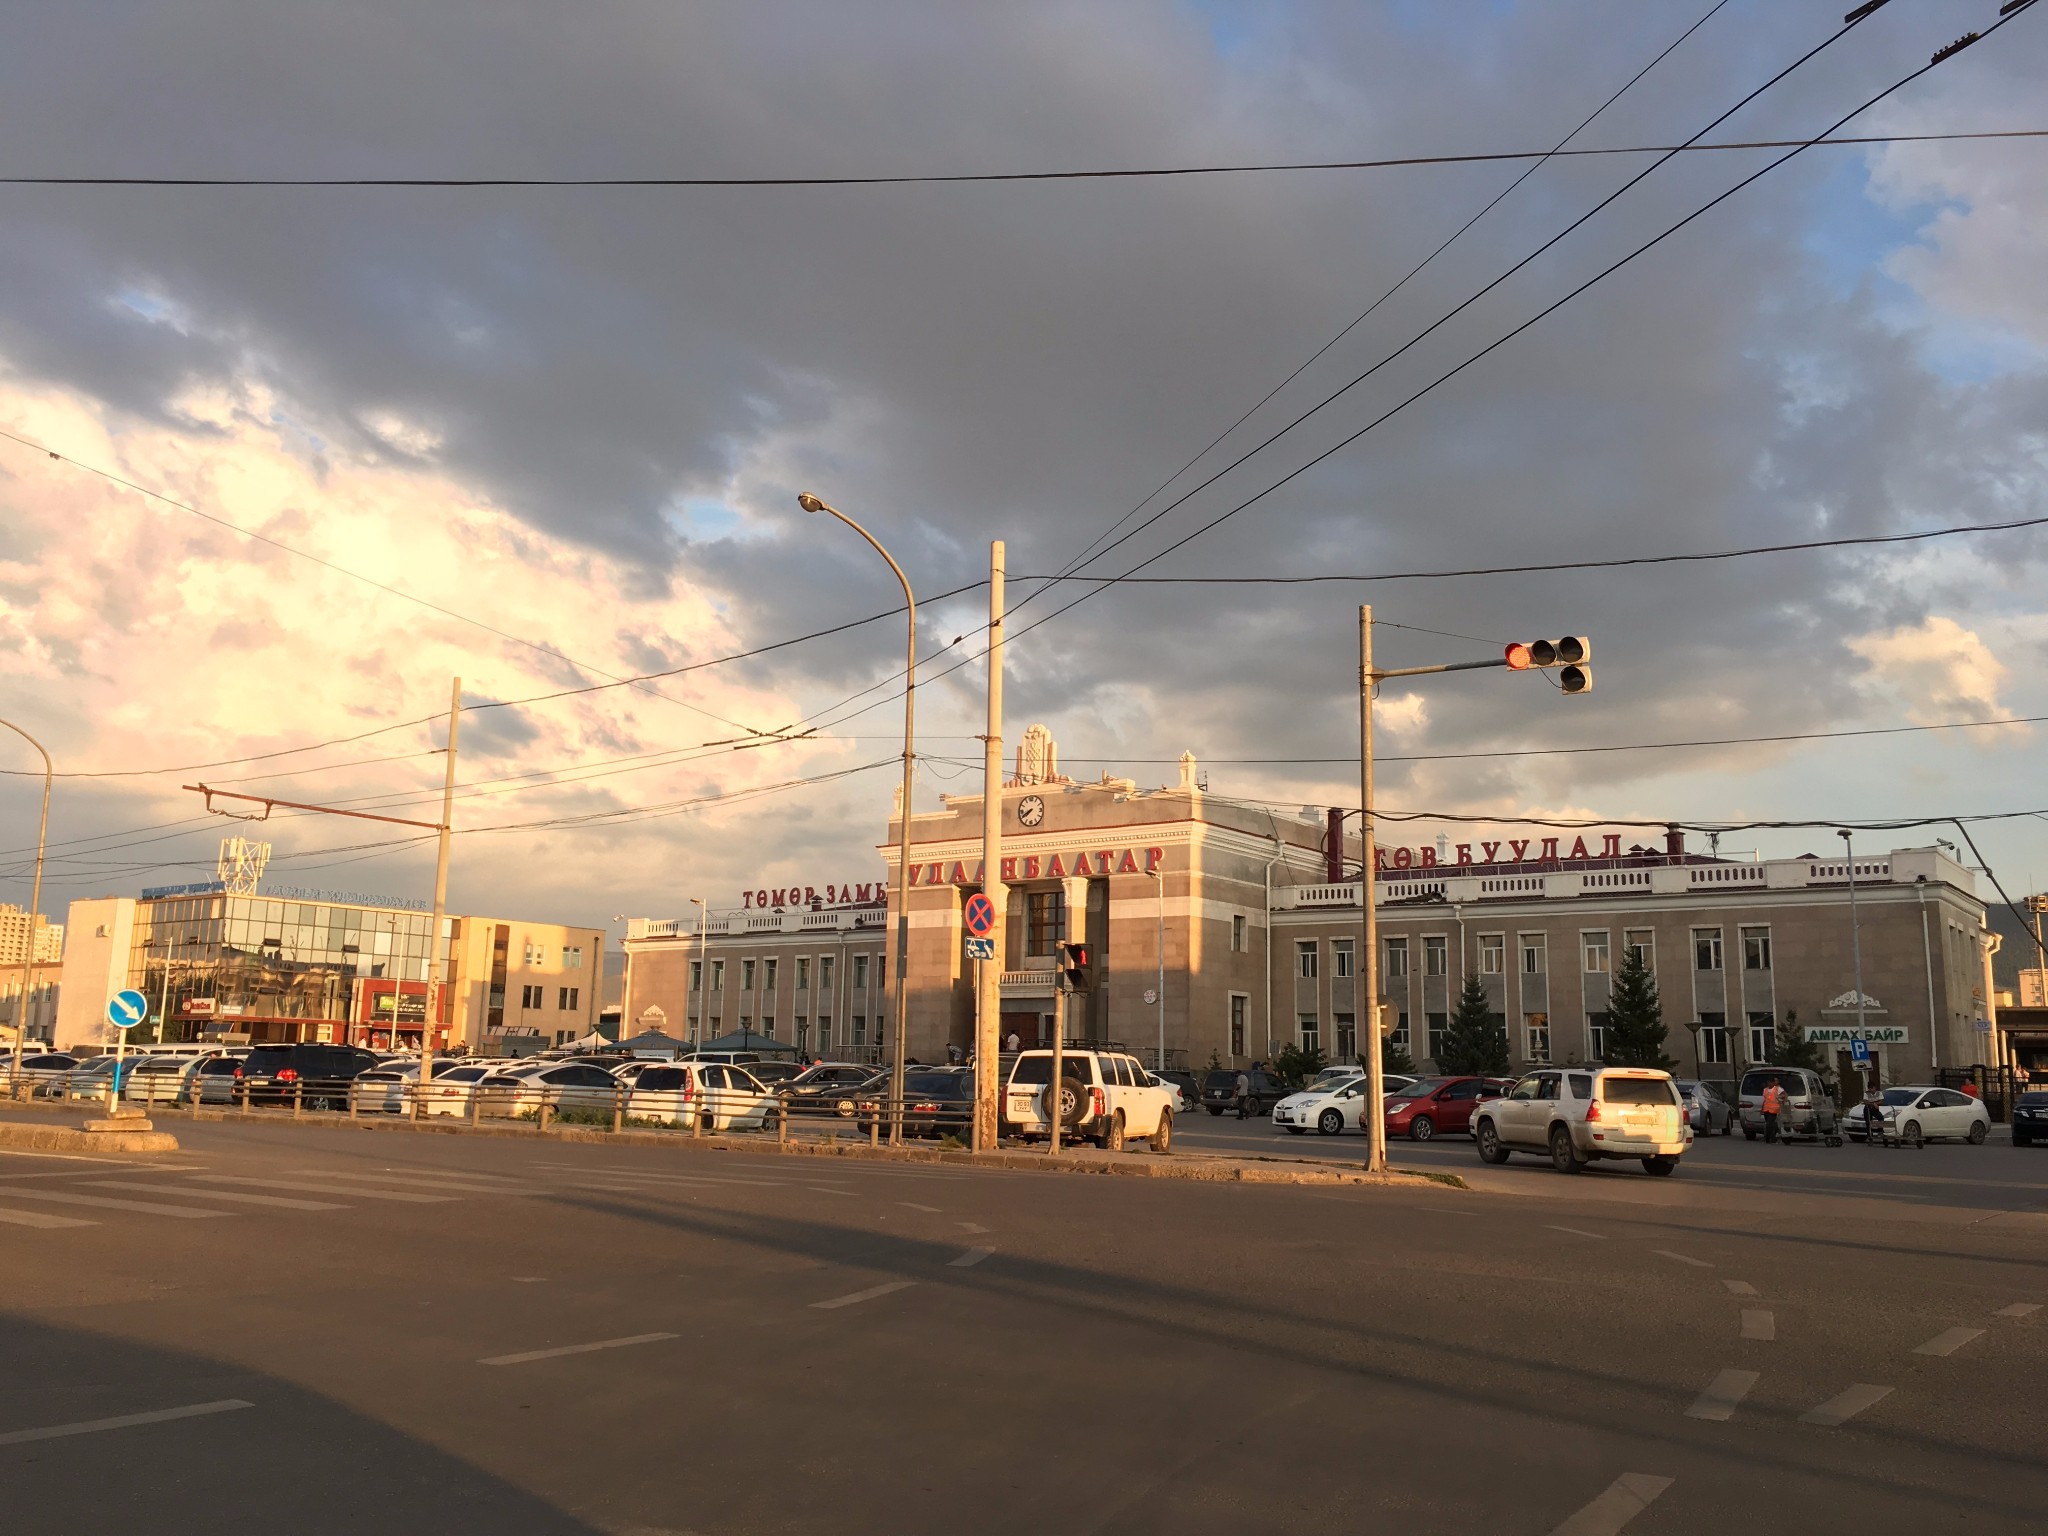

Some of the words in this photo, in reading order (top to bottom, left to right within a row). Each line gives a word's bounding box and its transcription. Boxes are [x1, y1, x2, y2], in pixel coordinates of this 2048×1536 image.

[1456, 834, 1622, 867] БУУДАЛ
[743, 887, 815, 908] ТӨМӨР
[1810, 1030, 1859, 1042] АМРАХ
[1865, 1028, 1904, 1042] БАЙР
[1855, 1042, 1865, 1058] P
